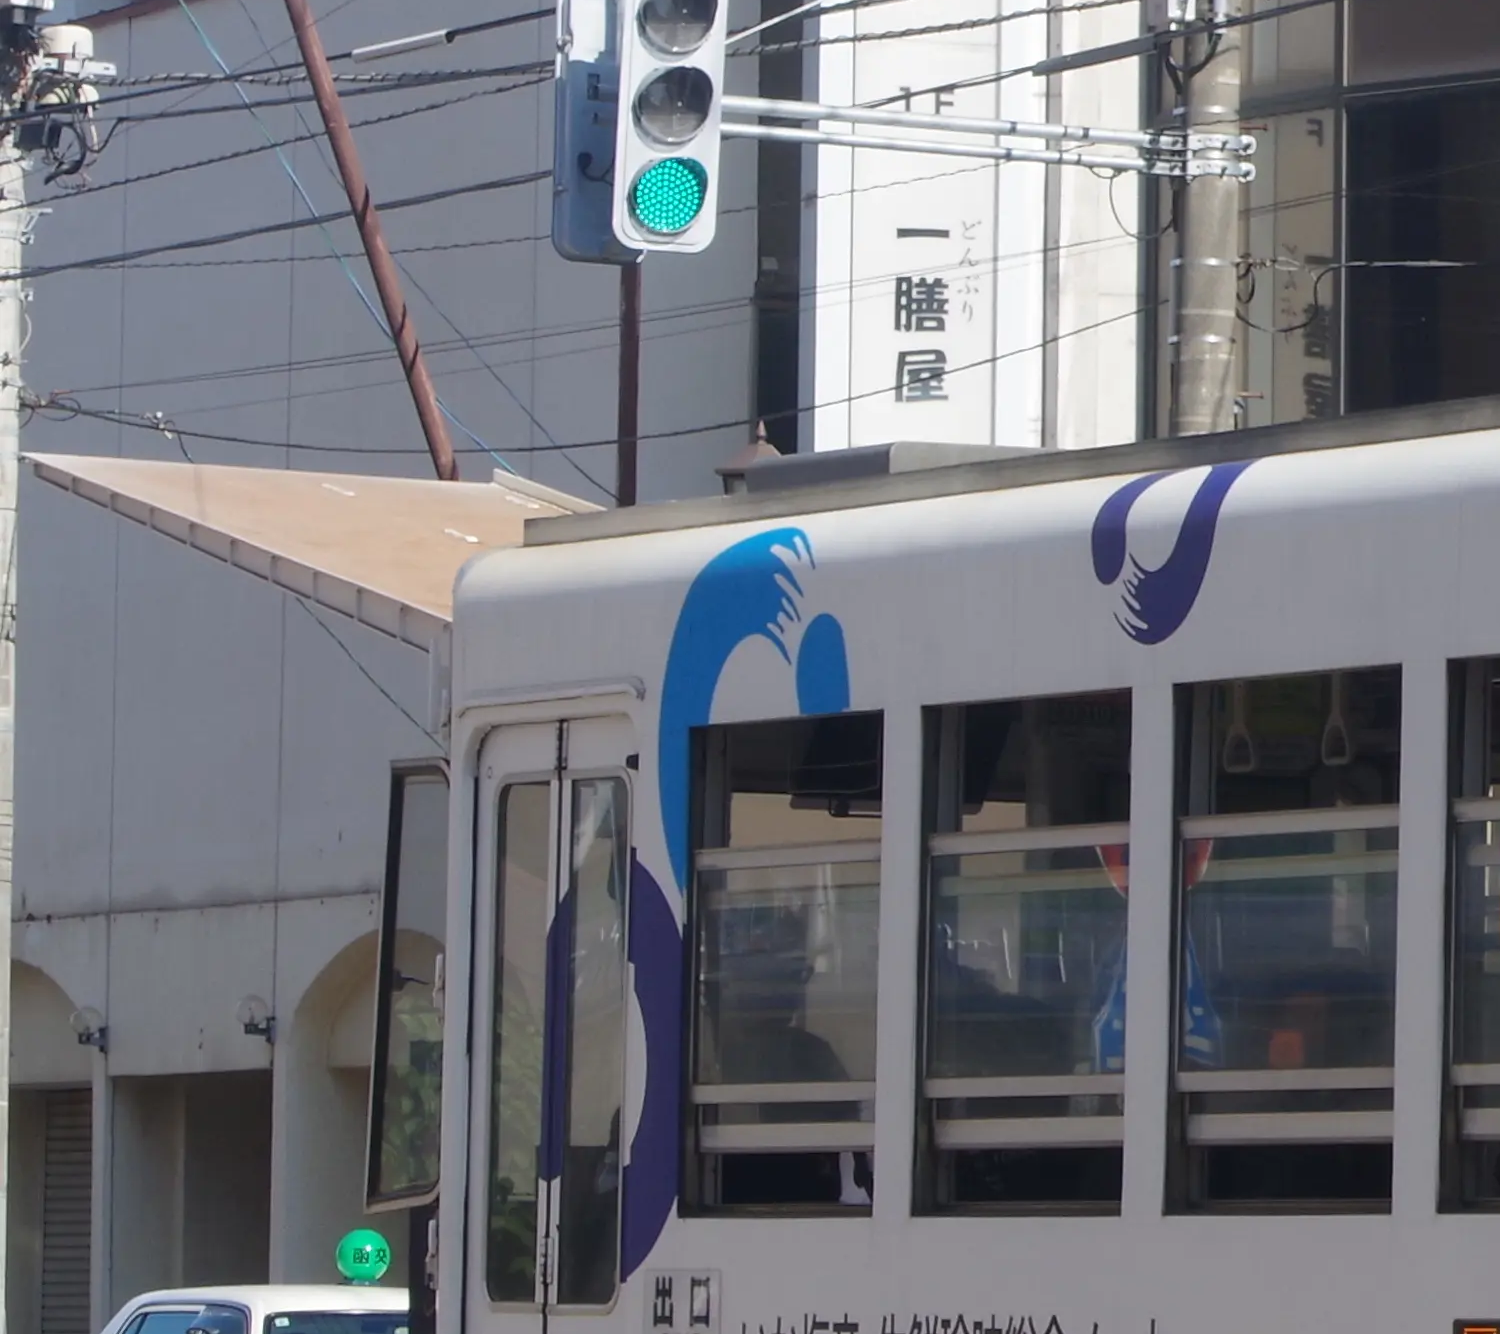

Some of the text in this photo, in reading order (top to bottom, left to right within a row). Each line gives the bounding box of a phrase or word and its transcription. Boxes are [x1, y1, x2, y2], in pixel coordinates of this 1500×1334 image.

[894, 227, 950, 402] 一膳屋
[957, 220, 981, 323] どんぶり
[652, 1275, 711, 1329] 出口
